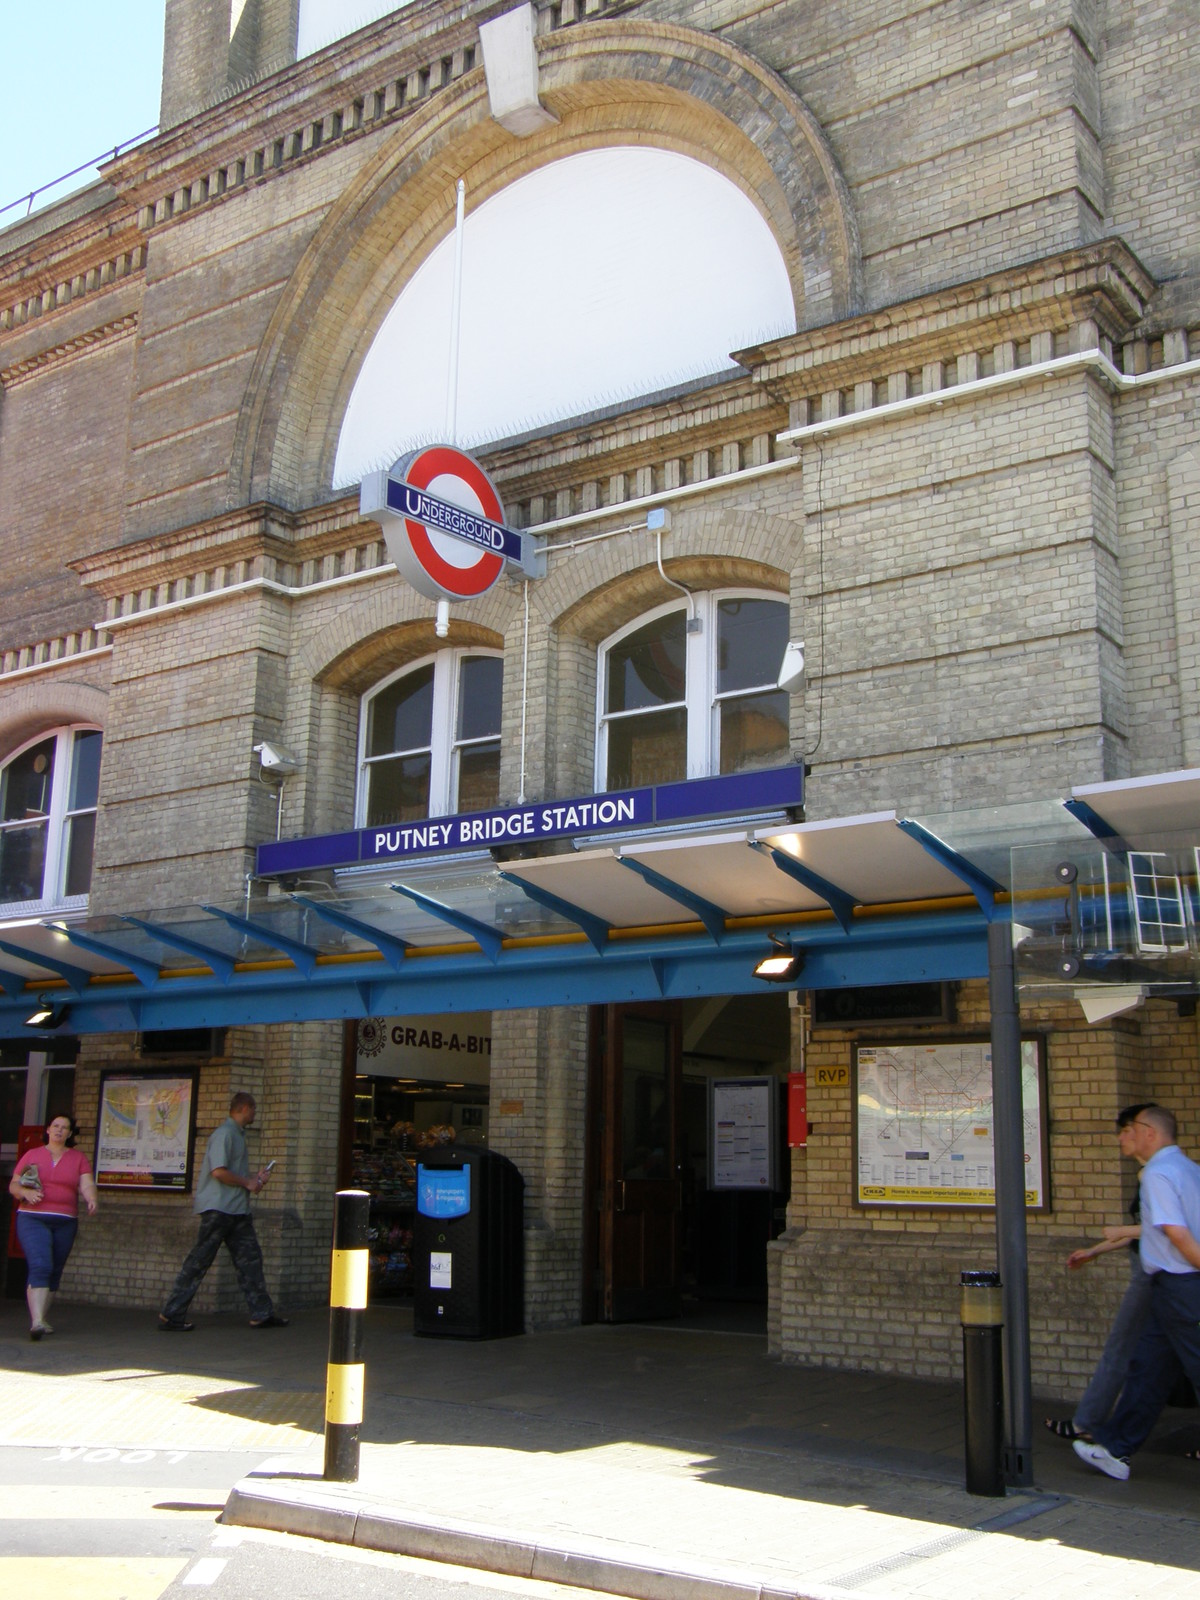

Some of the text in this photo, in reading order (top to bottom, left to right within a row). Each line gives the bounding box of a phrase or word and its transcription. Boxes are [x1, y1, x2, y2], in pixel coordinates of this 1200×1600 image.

[406, 489, 504, 550] UNDERGROUND
[375, 798, 635, 854] PUTNEY BRIDGE STATION
[391, 1025, 492, 1055] GRAB-A-BIT
[818, 1069, 846, 1083] RVP
[42, 1447, 190, 1464] LOOK
